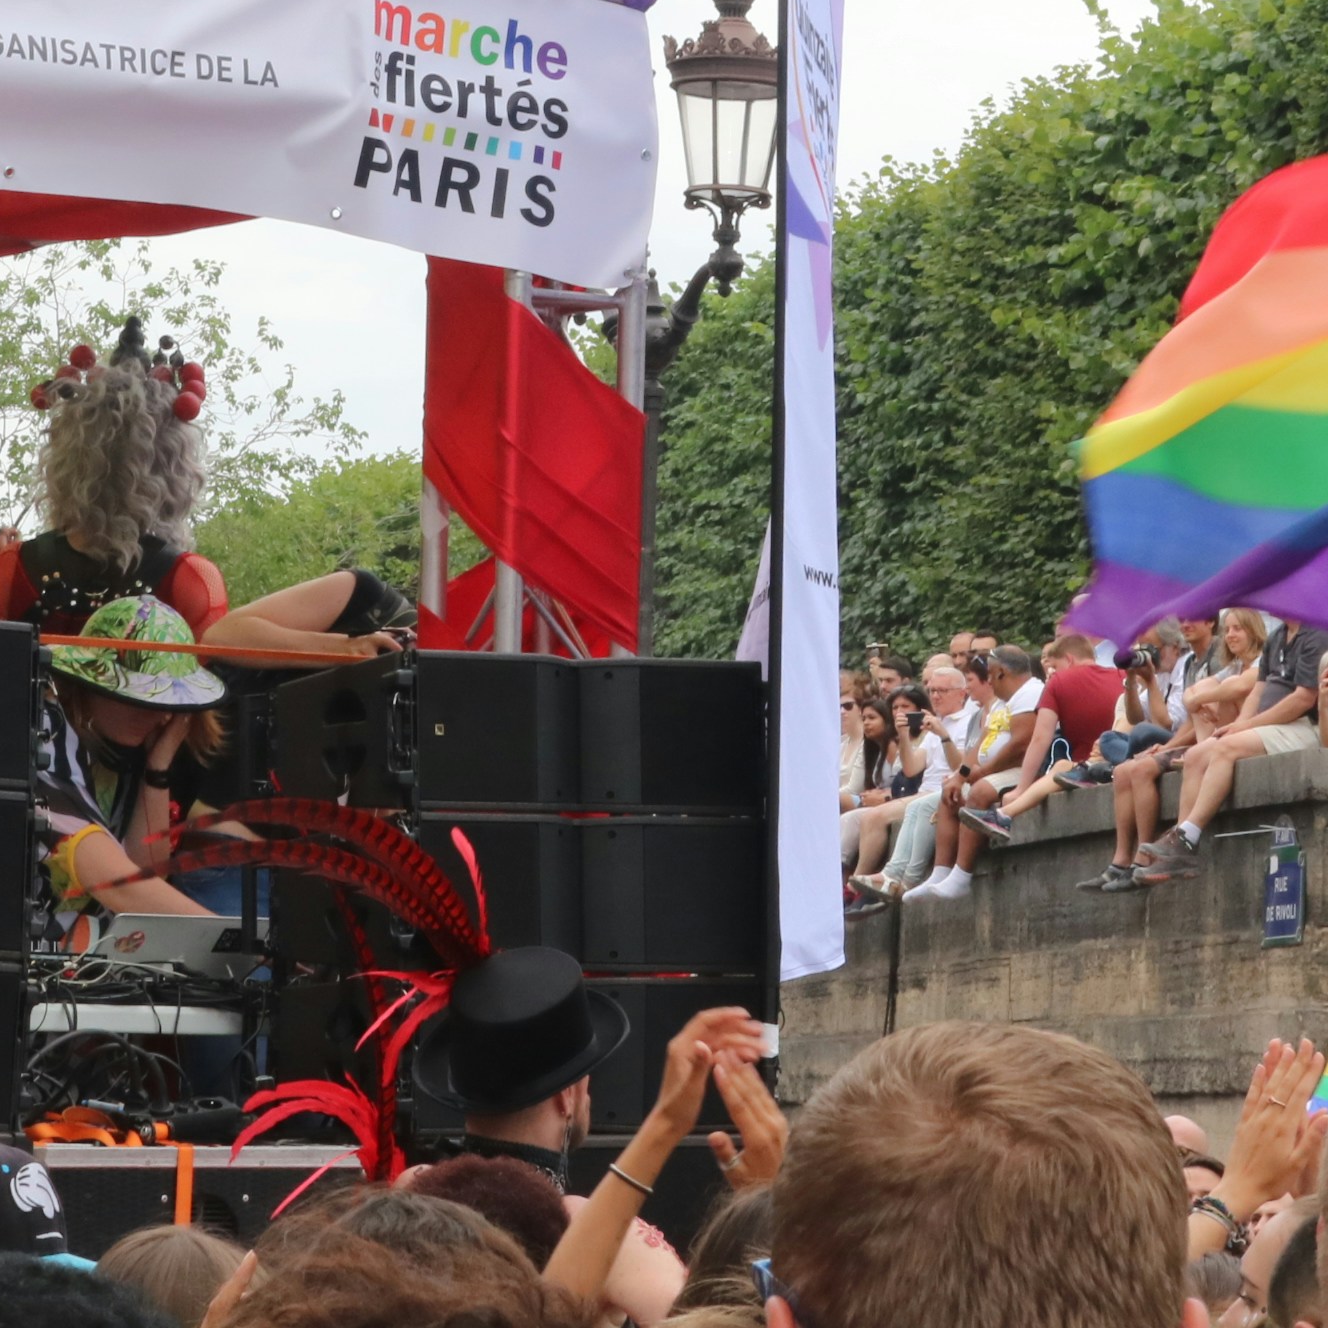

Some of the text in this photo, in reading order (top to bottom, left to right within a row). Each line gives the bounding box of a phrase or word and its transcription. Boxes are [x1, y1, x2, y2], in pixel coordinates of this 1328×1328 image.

[196, 53, 233, 83] DE
[242, 58, 279, 88] LA
[384, 51, 569, 139] fiertés
[353, 136, 556, 227] PARIS
[1274, 876, 1288, 892] RUE
[1266, 903, 1296, 922] DE RIVOLI
